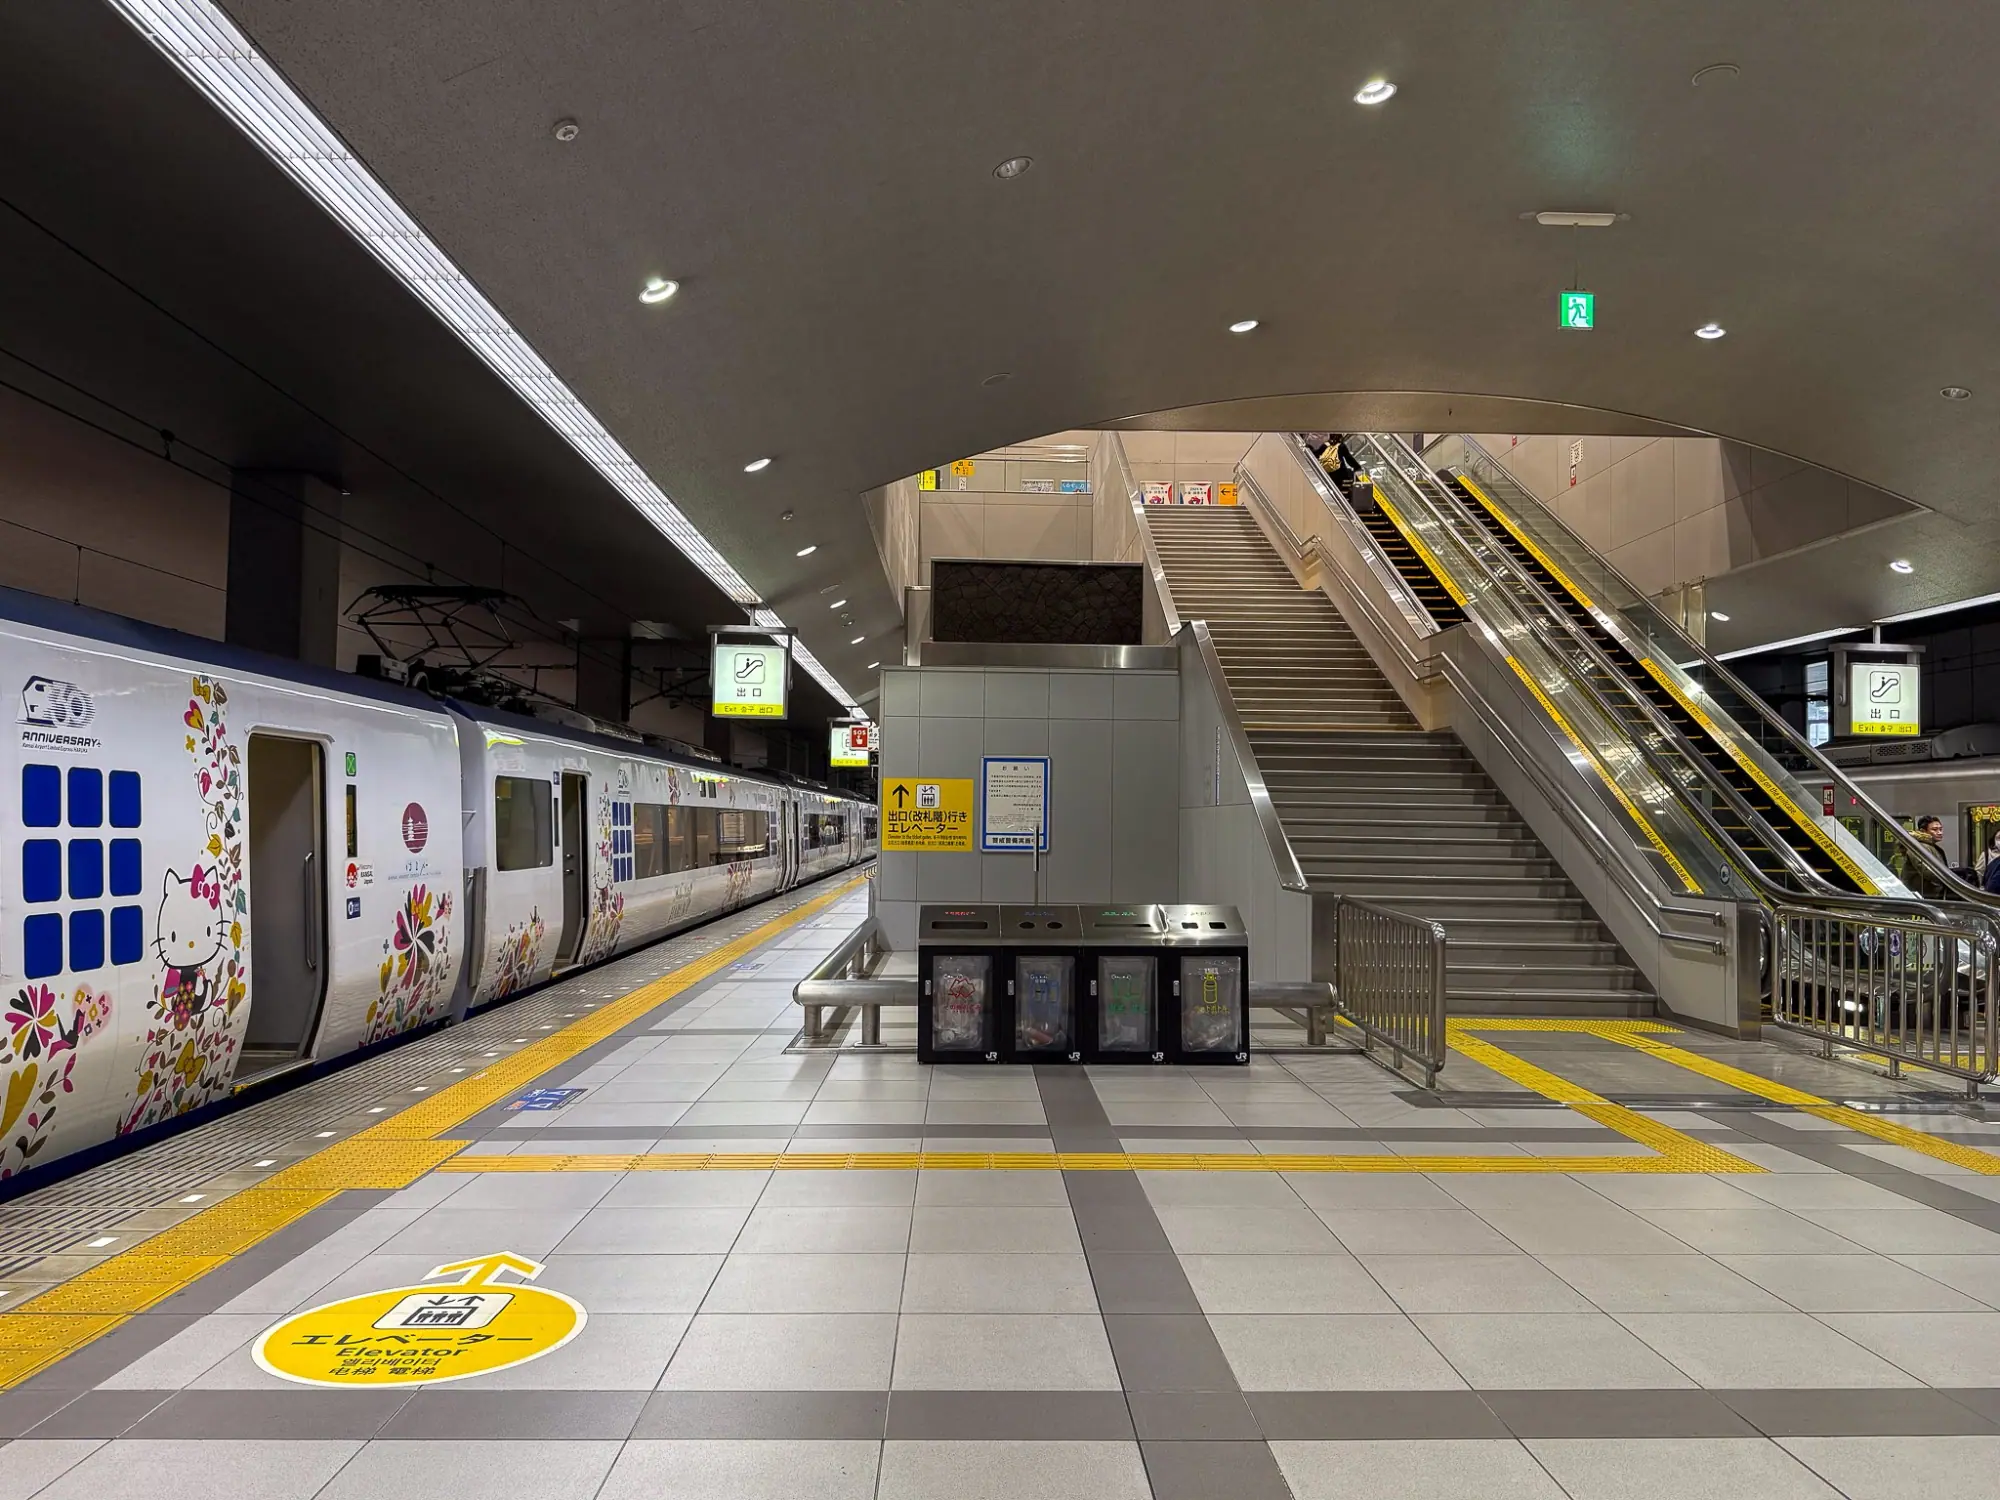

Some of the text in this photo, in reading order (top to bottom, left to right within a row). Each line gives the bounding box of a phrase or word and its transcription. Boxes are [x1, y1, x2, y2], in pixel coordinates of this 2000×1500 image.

[736, 687, 762, 697] 出口
[1870, 708, 1900, 719] 出口
[22, 732, 98, 747] ANNIVERSARY
[888, 810, 967, 823] 出口(改札階)行き
[888, 823, 958, 833] エレベーター
[292, 1334, 533, 1346] エレベーター
[336, 1347, 468, 1357] Elevator
[329, 1367, 376, 1376] 电梯
